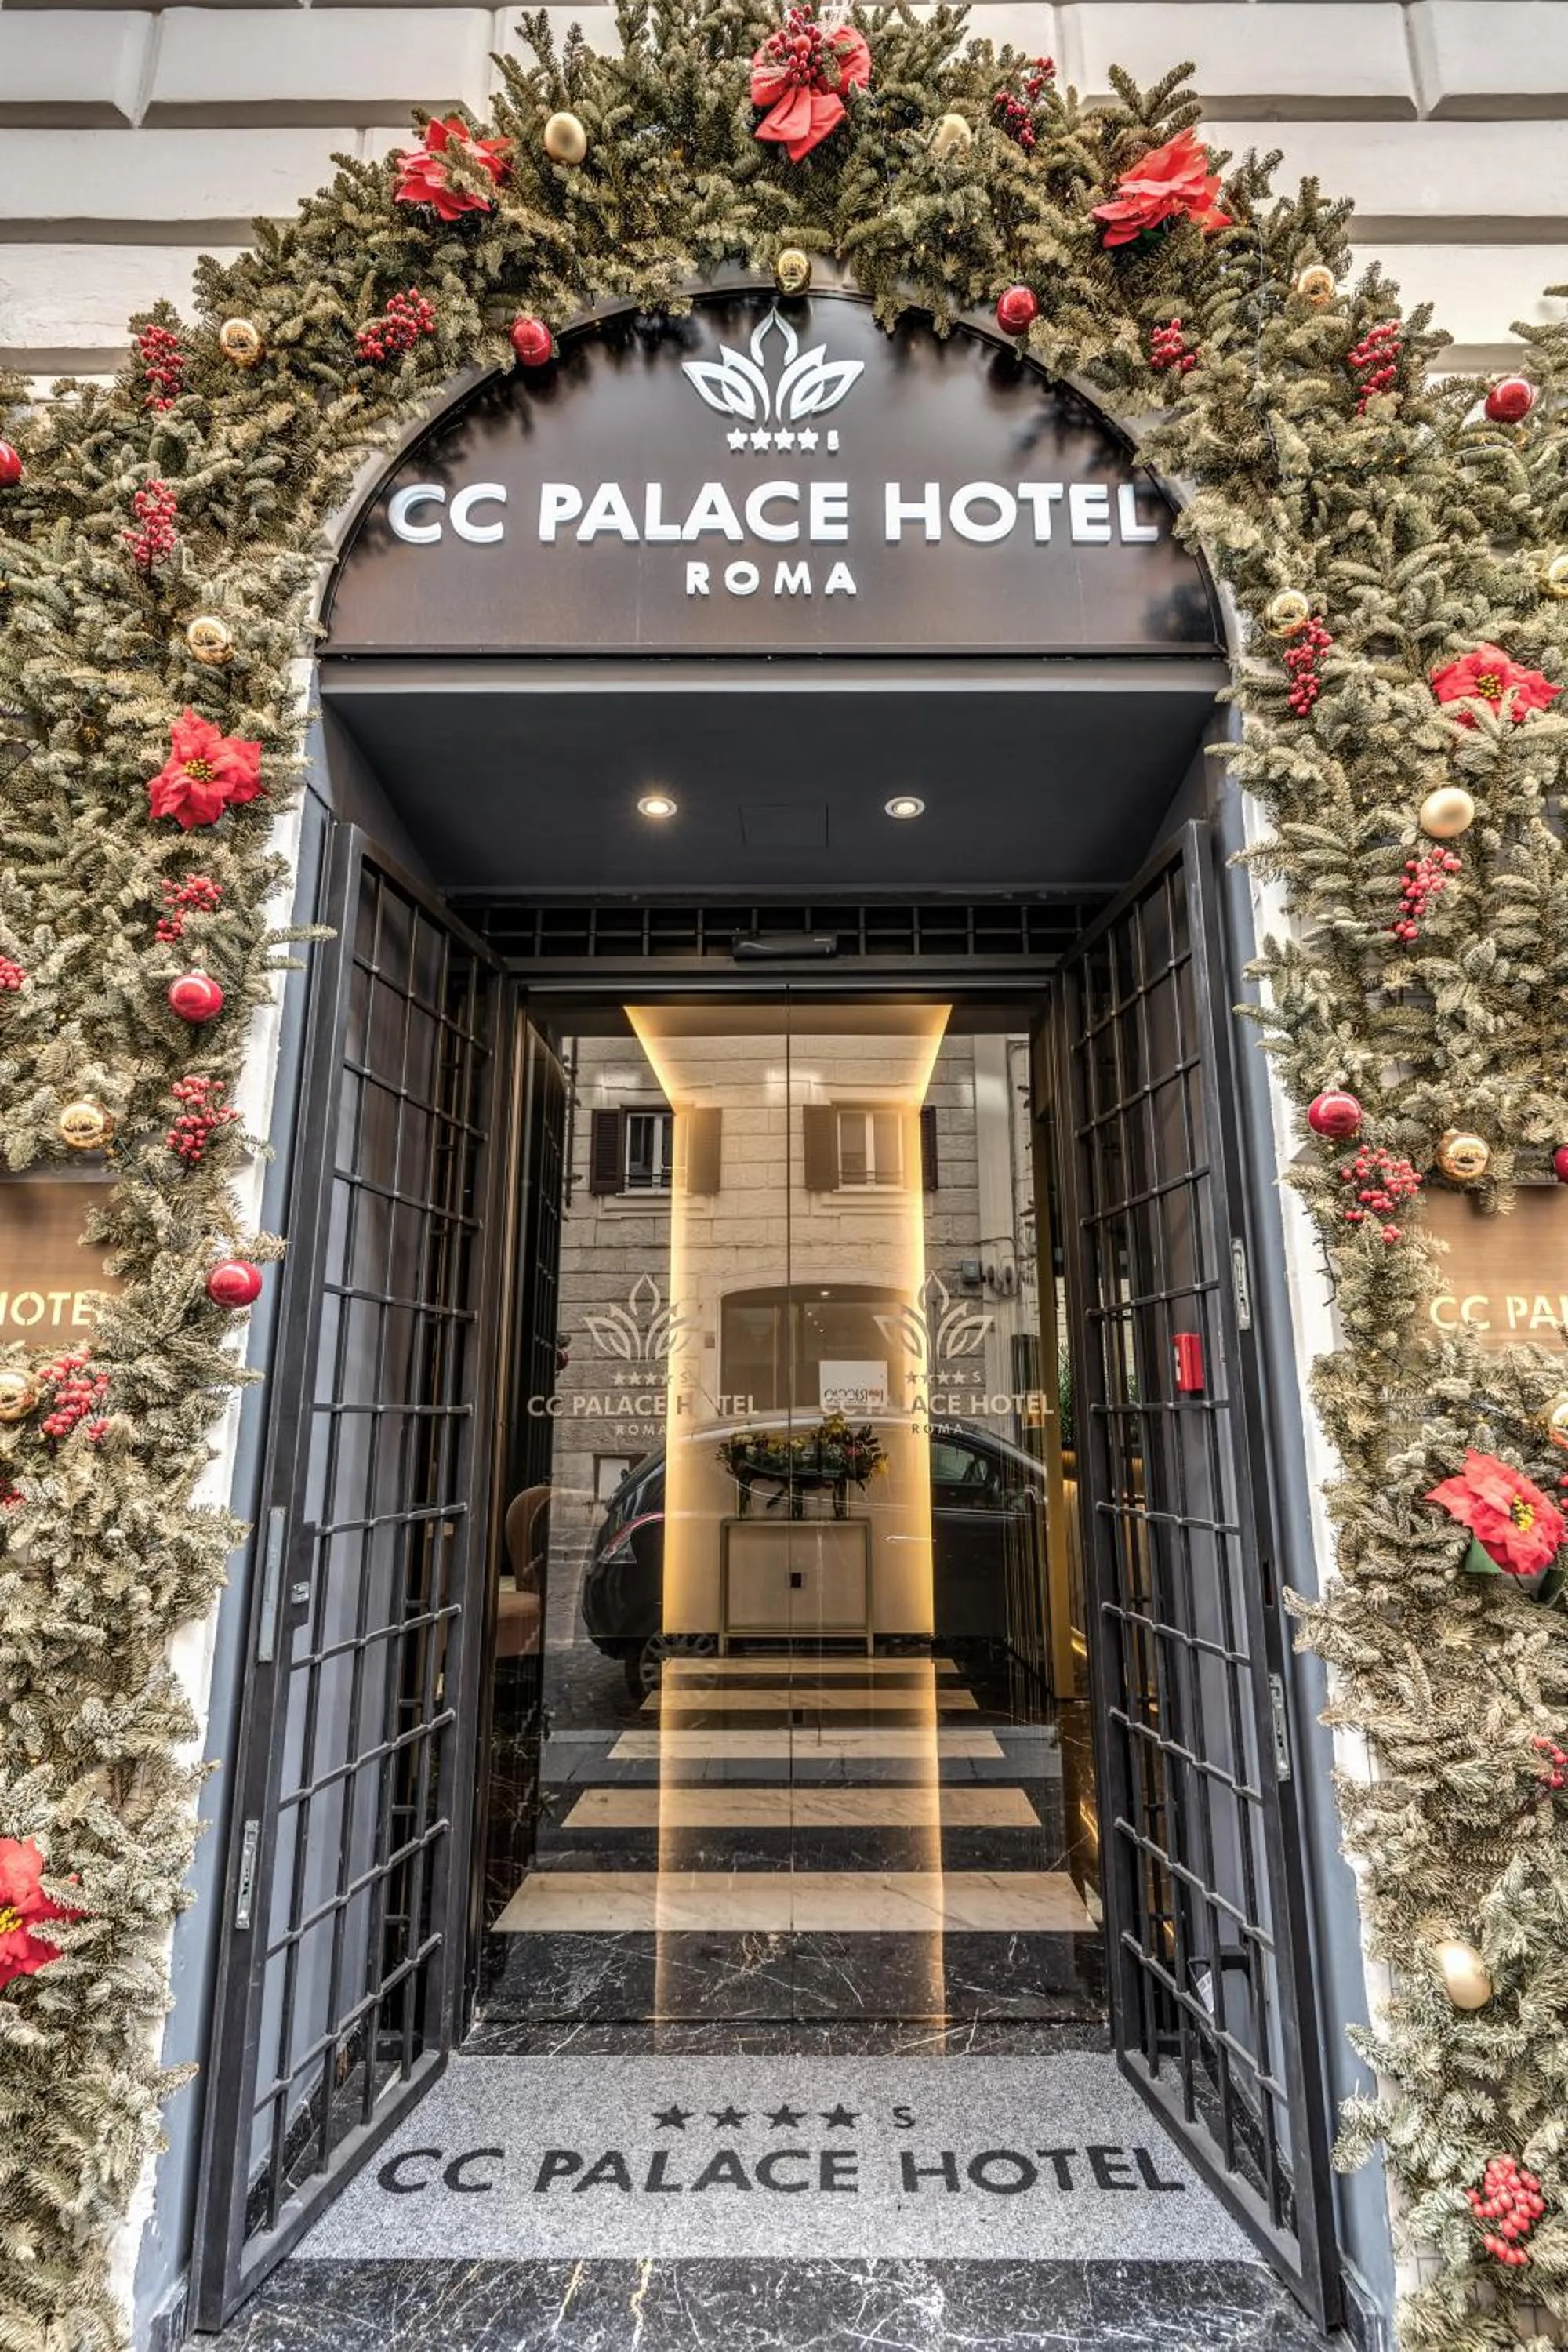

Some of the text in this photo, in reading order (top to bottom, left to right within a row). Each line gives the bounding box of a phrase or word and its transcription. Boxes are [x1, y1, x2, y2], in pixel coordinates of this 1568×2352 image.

[388, 482, 1159, 544] CC PALACE HOTEL
[686, 561, 857, 596] ROMA
[1429, 1295, 1490, 1330] CC
[972, 1370, 982, 1384] S
[527, 1394, 760, 1417] CC PALACE HTEL
[970, 1393, 1054, 1415] HOTEL
[615, 1424, 667, 1436] ROMA
[911, 1422, 964, 1435] ROMA
[892, 2107, 914, 2129] S
[376, 2146, 1186, 2194] CC PALACE HOTEL
